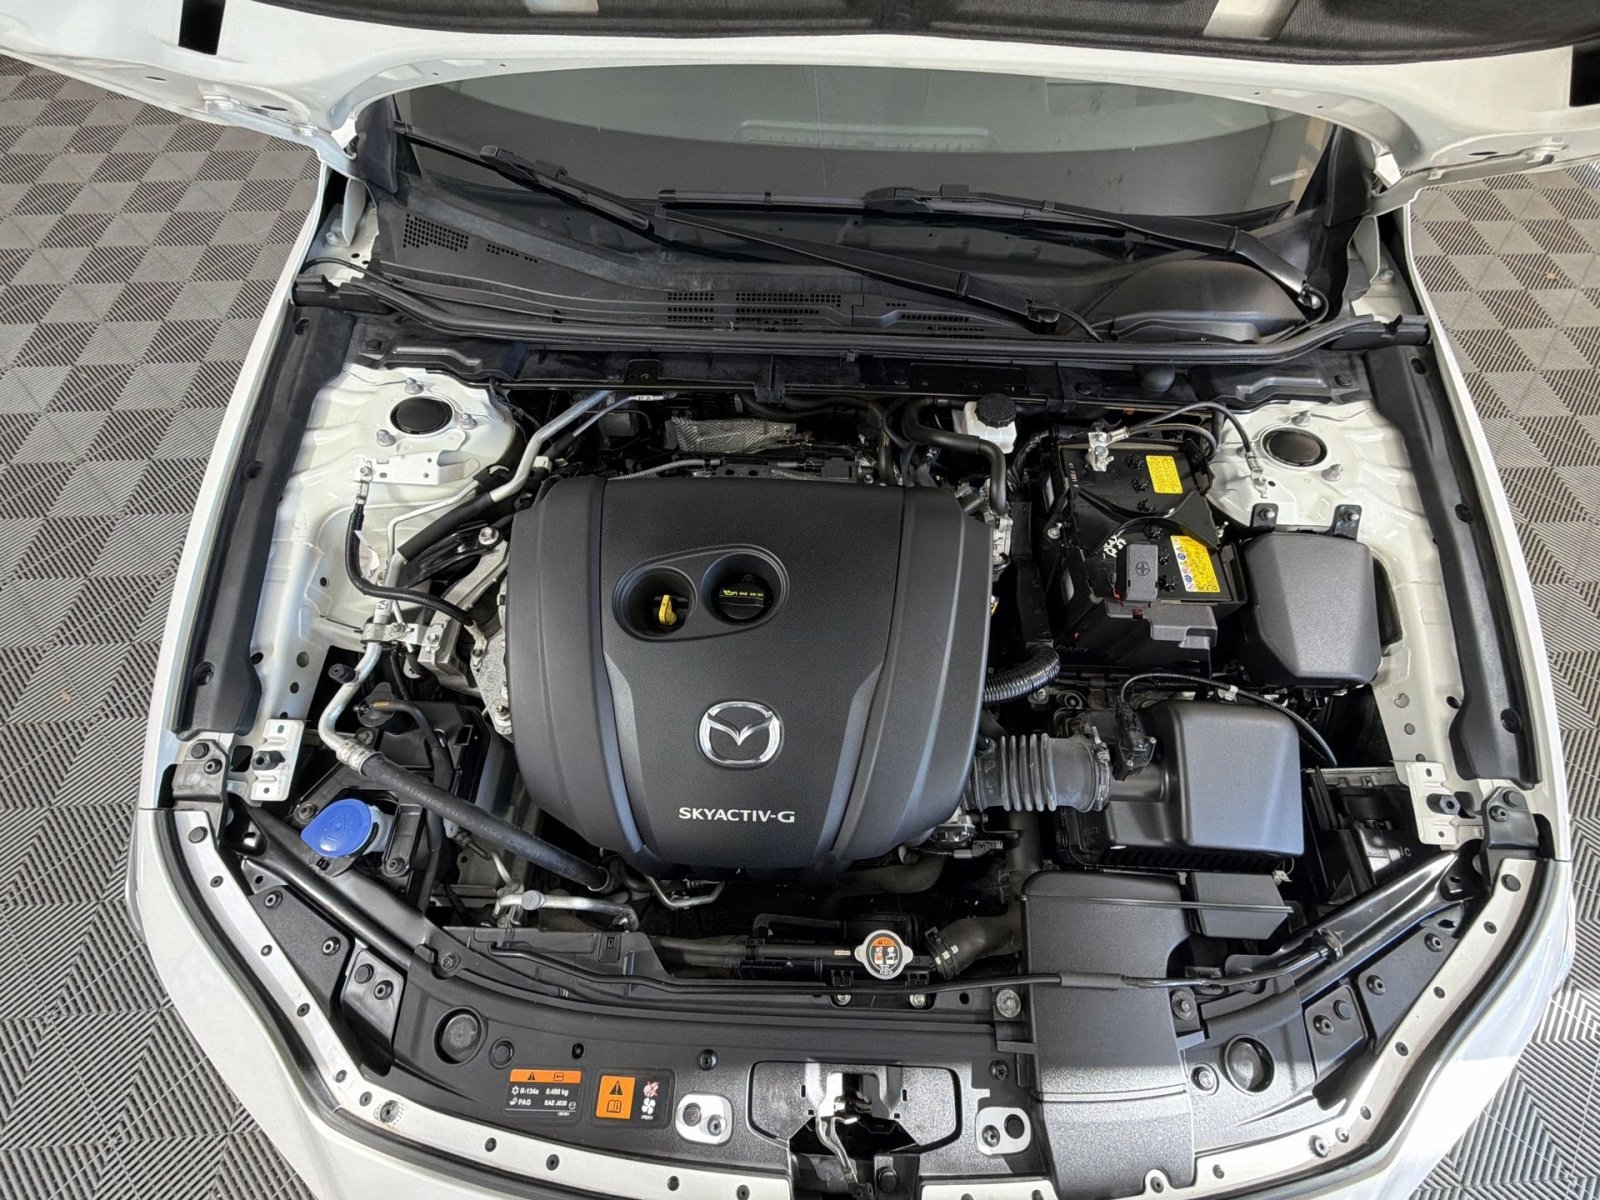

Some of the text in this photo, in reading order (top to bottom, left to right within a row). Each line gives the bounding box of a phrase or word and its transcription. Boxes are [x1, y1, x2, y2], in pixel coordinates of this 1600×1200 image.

[678, 807, 796, 823] SKYACTIV-G
[519, 1087, 539, 1095] R-134a
[561, 1088, 569, 1096] kg
